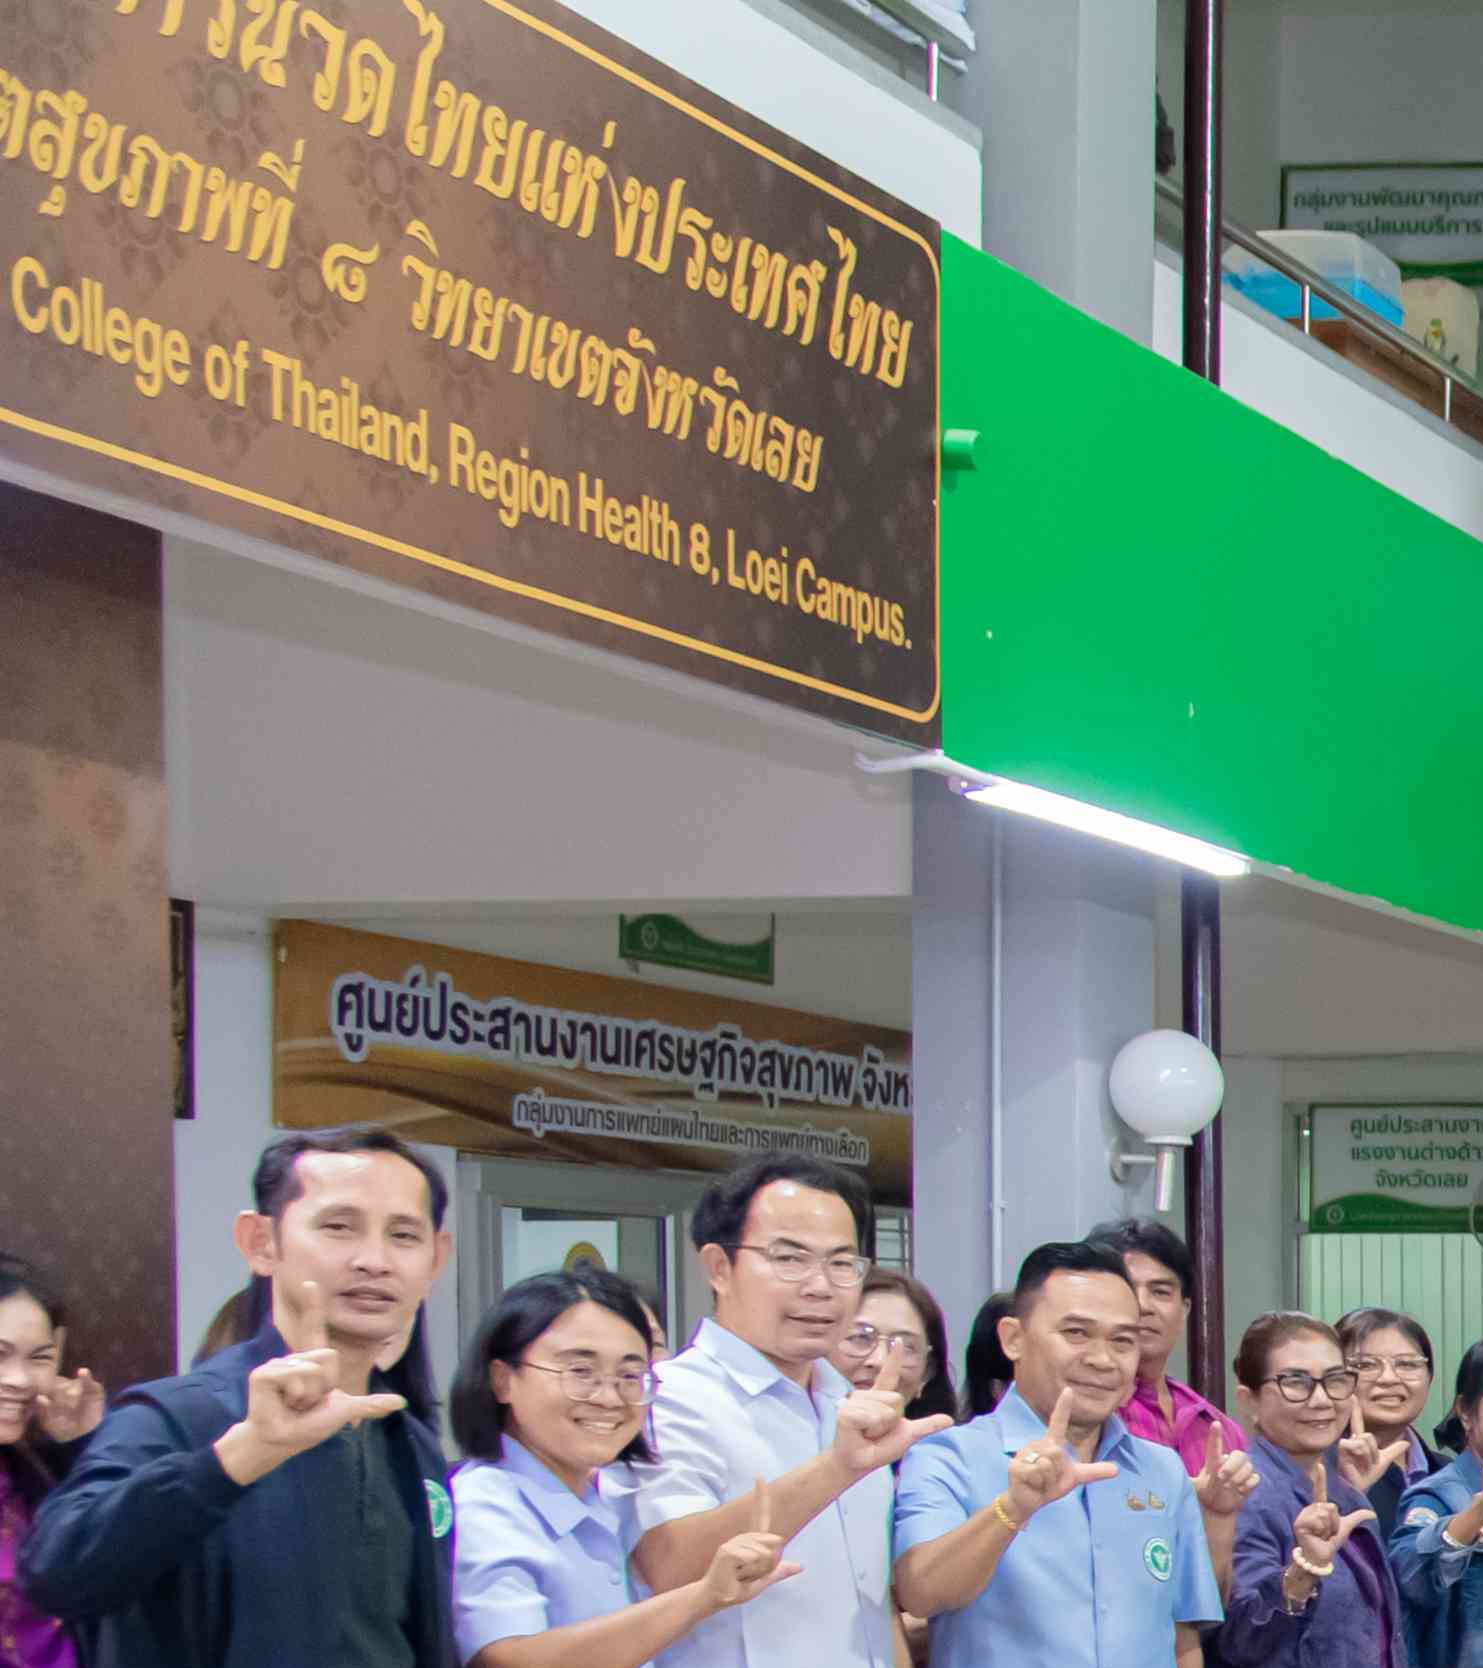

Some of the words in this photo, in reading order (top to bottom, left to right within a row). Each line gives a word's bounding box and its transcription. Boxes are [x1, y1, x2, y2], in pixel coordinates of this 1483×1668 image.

[113, 0, 914, 388] รนวดไทยแห่งประเทศไทย
[11, 256, 191, 397] College
[204, 340, 250, 408] of
[262, 348, 439, 484] Thailand,
[448, 420, 570, 529] Region
[578, 472, 681, 567] Health
[688, 522, 720, 586] 8,
[727, 528, 789, 605] Loei
[795, 557, 913, 650] Campus.
[322, 242, 380, 302] ๘
[402, 220, 824, 493] วิทยาเขตจังหวัดเลย
[337, 976, 853, 1108] ศูนย์ประสานงานเศรษฐกิจสุขภาพ
[862, 1052, 911, 1108] จังห
[1375, 1168, 1468, 1188] จังหวัดเลย
